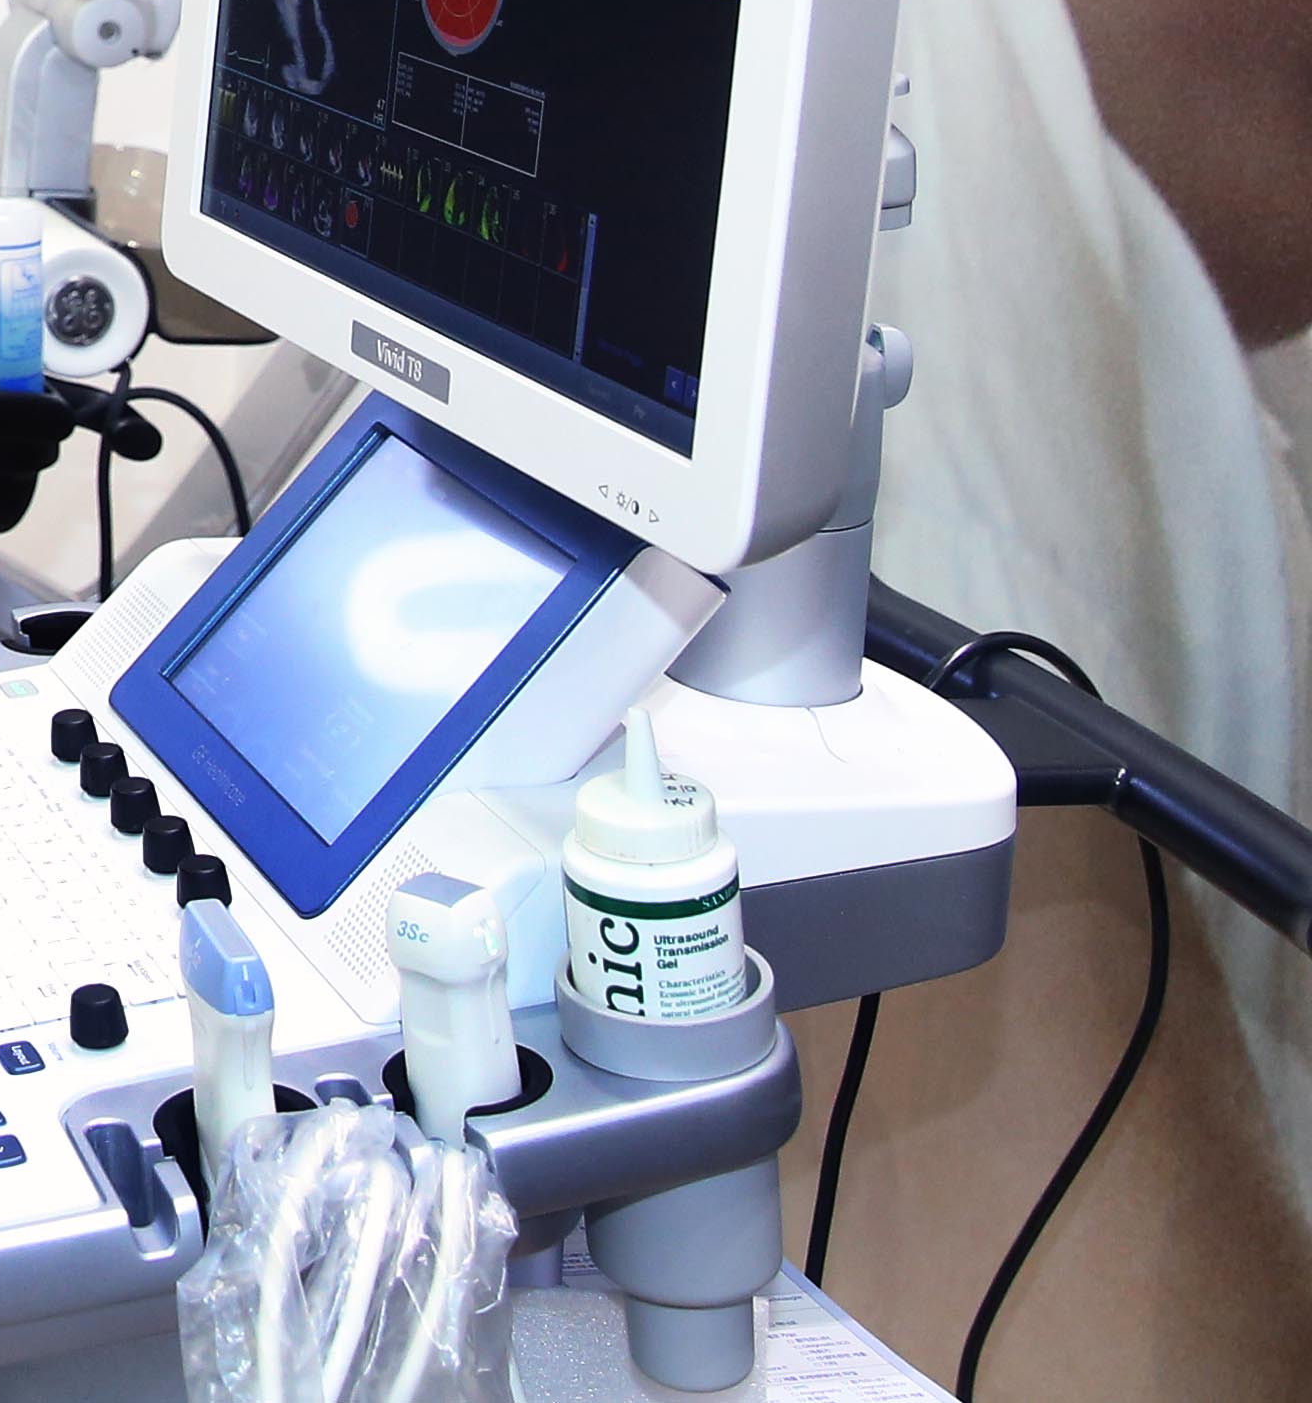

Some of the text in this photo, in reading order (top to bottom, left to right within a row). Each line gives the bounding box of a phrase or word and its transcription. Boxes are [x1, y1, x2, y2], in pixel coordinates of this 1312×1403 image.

[377, 339, 423, 382] Vivid T8
[396, 920, 430, 944] 3Sc
[653, 925, 720, 946] Ultrasound
[655, 934, 729, 958] Transmission
[657, 959, 678, 970] Gel
[658, 969, 726, 989] Characteristics
[13, 1045, 31, 1067] Layout
